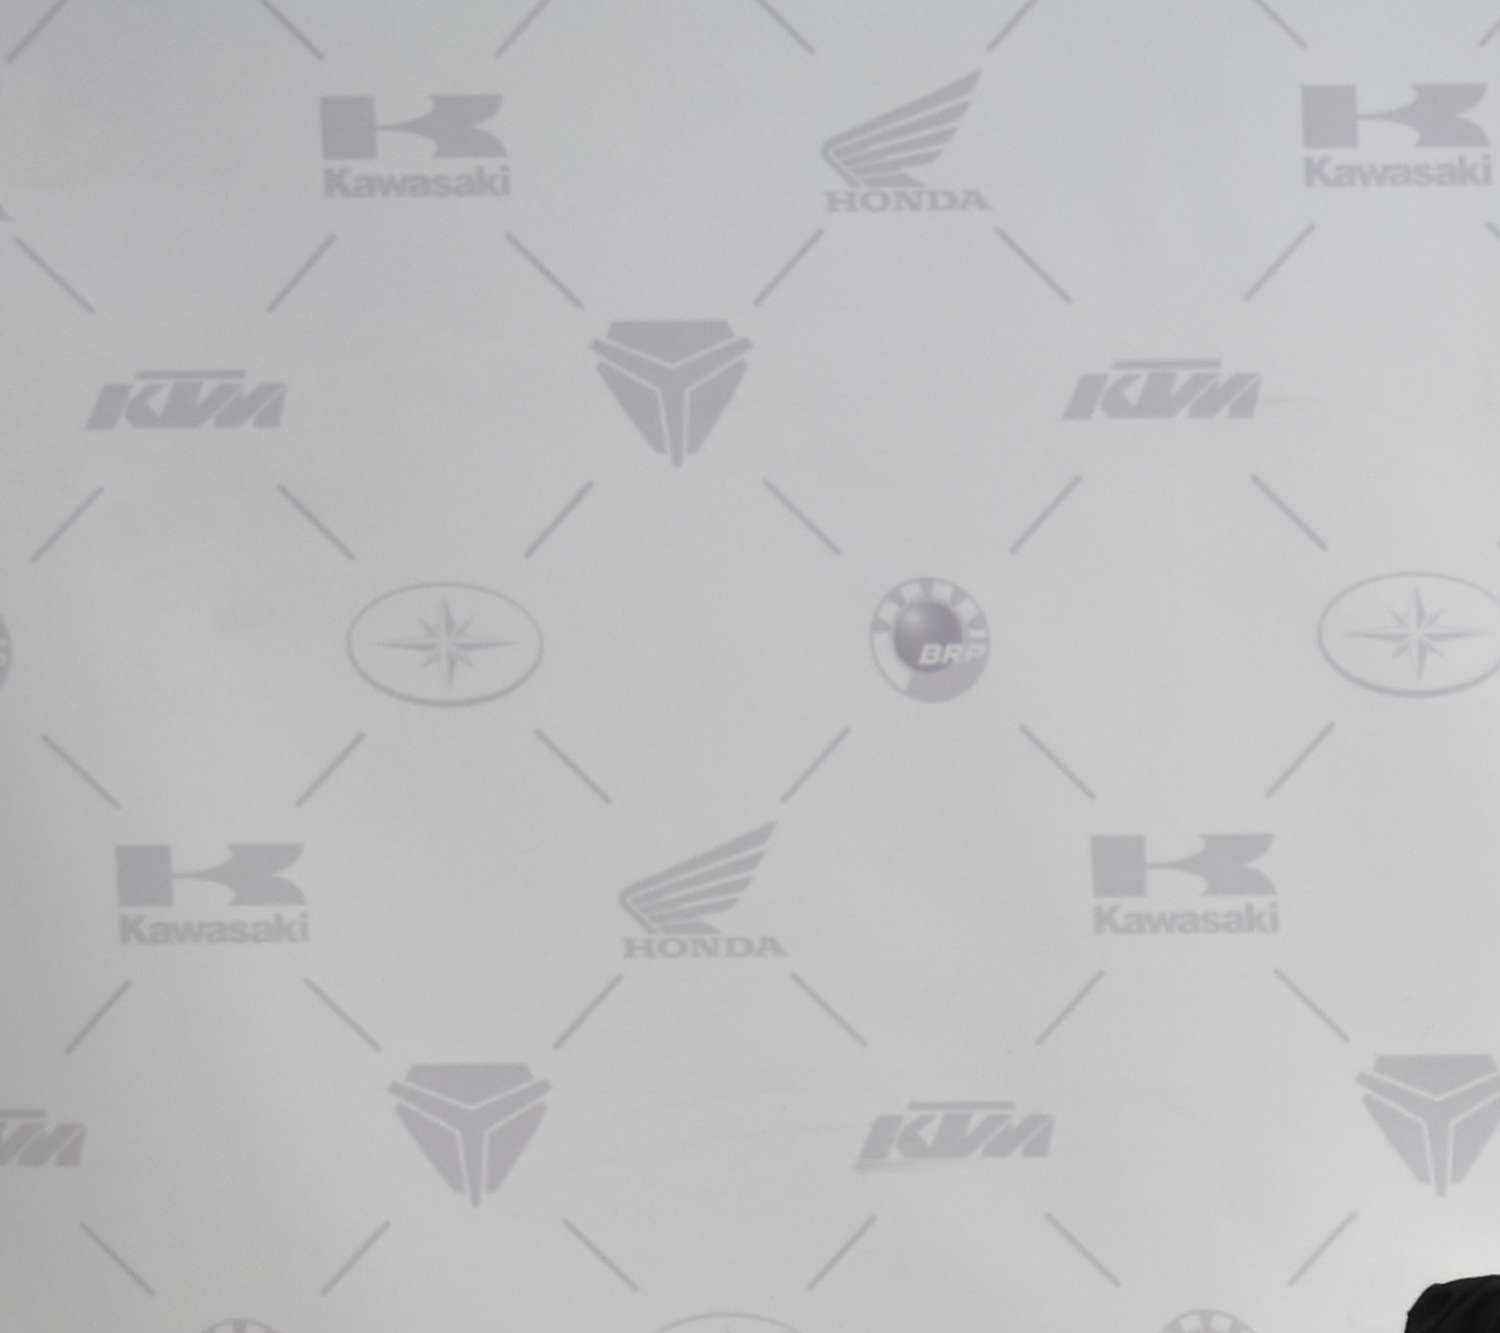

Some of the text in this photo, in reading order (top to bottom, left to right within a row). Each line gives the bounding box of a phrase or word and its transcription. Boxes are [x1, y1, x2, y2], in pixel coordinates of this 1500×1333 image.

[323, 166, 509, 199] Kawasaki
[1303, 154, 1492, 187] Kawasaki
[825, 190, 990, 211] HONDA
[86, 370, 285, 430] KTM
[1063, 360, 1260, 420] KTM
[919, 643, 987, 666] BRP
[116, 913, 307, 946] Kawasaki
[1093, 903, 1278, 935] Kawasaki
[624, 936, 786, 958] HONDA
[859, 1101, 1053, 1158] KTM
